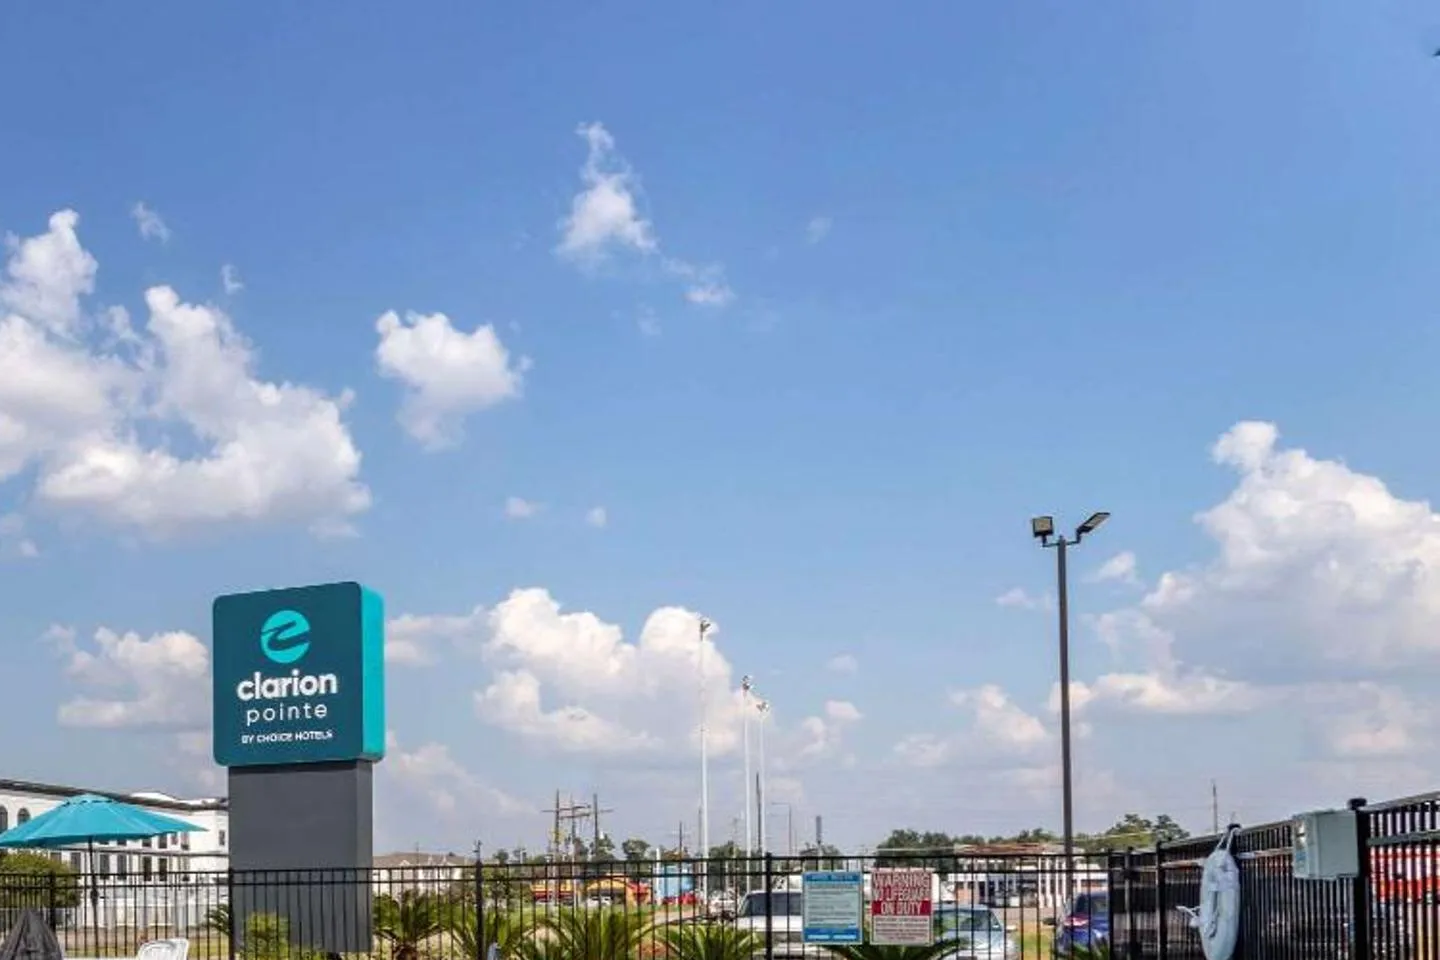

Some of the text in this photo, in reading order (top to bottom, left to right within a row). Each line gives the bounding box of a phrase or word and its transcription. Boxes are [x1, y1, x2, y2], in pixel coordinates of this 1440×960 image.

[237, 669, 338, 700] clarion
[246, 703, 328, 726] pointe
[241, 730, 333, 744] BY CHOICE HOTELS
[873, 872, 930, 887] WARNING
[880, 901, 922, 915] ON DUTY
